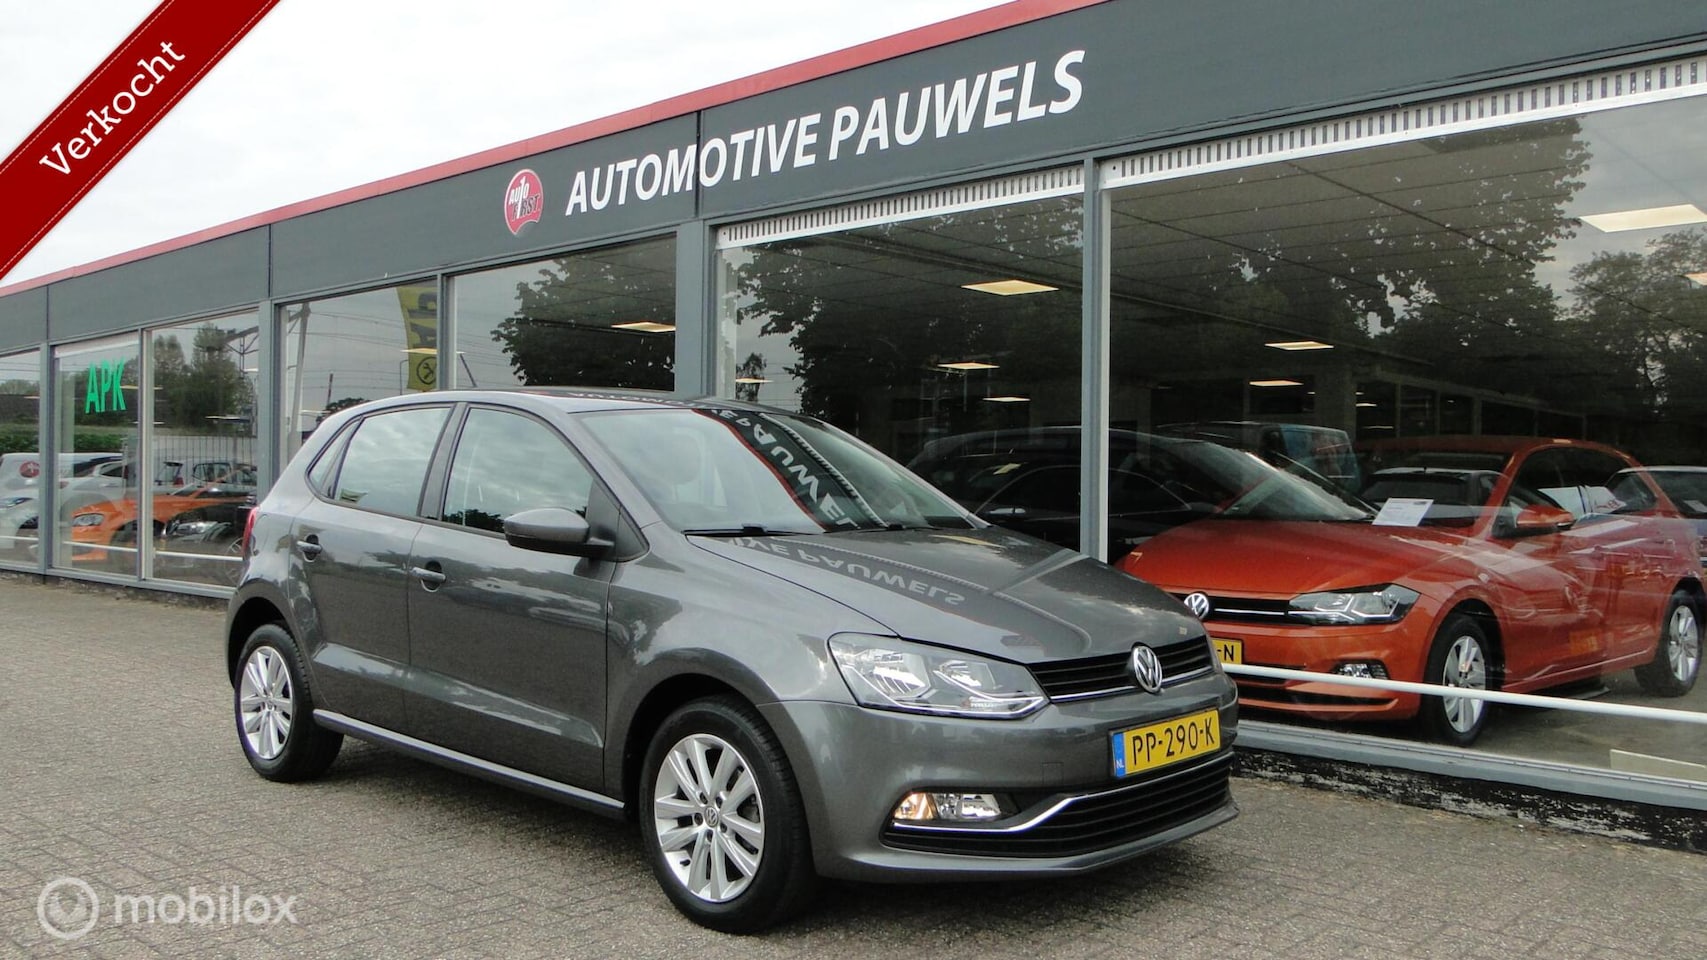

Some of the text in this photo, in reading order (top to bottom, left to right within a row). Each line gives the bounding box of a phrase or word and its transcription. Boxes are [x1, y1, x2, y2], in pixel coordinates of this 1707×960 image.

[566, 50, 1085, 216] AUTOMOTIVE PAUWELS
[85, 357, 127, 414] APK
[1132, 716, 1215, 766] PP-290-K
